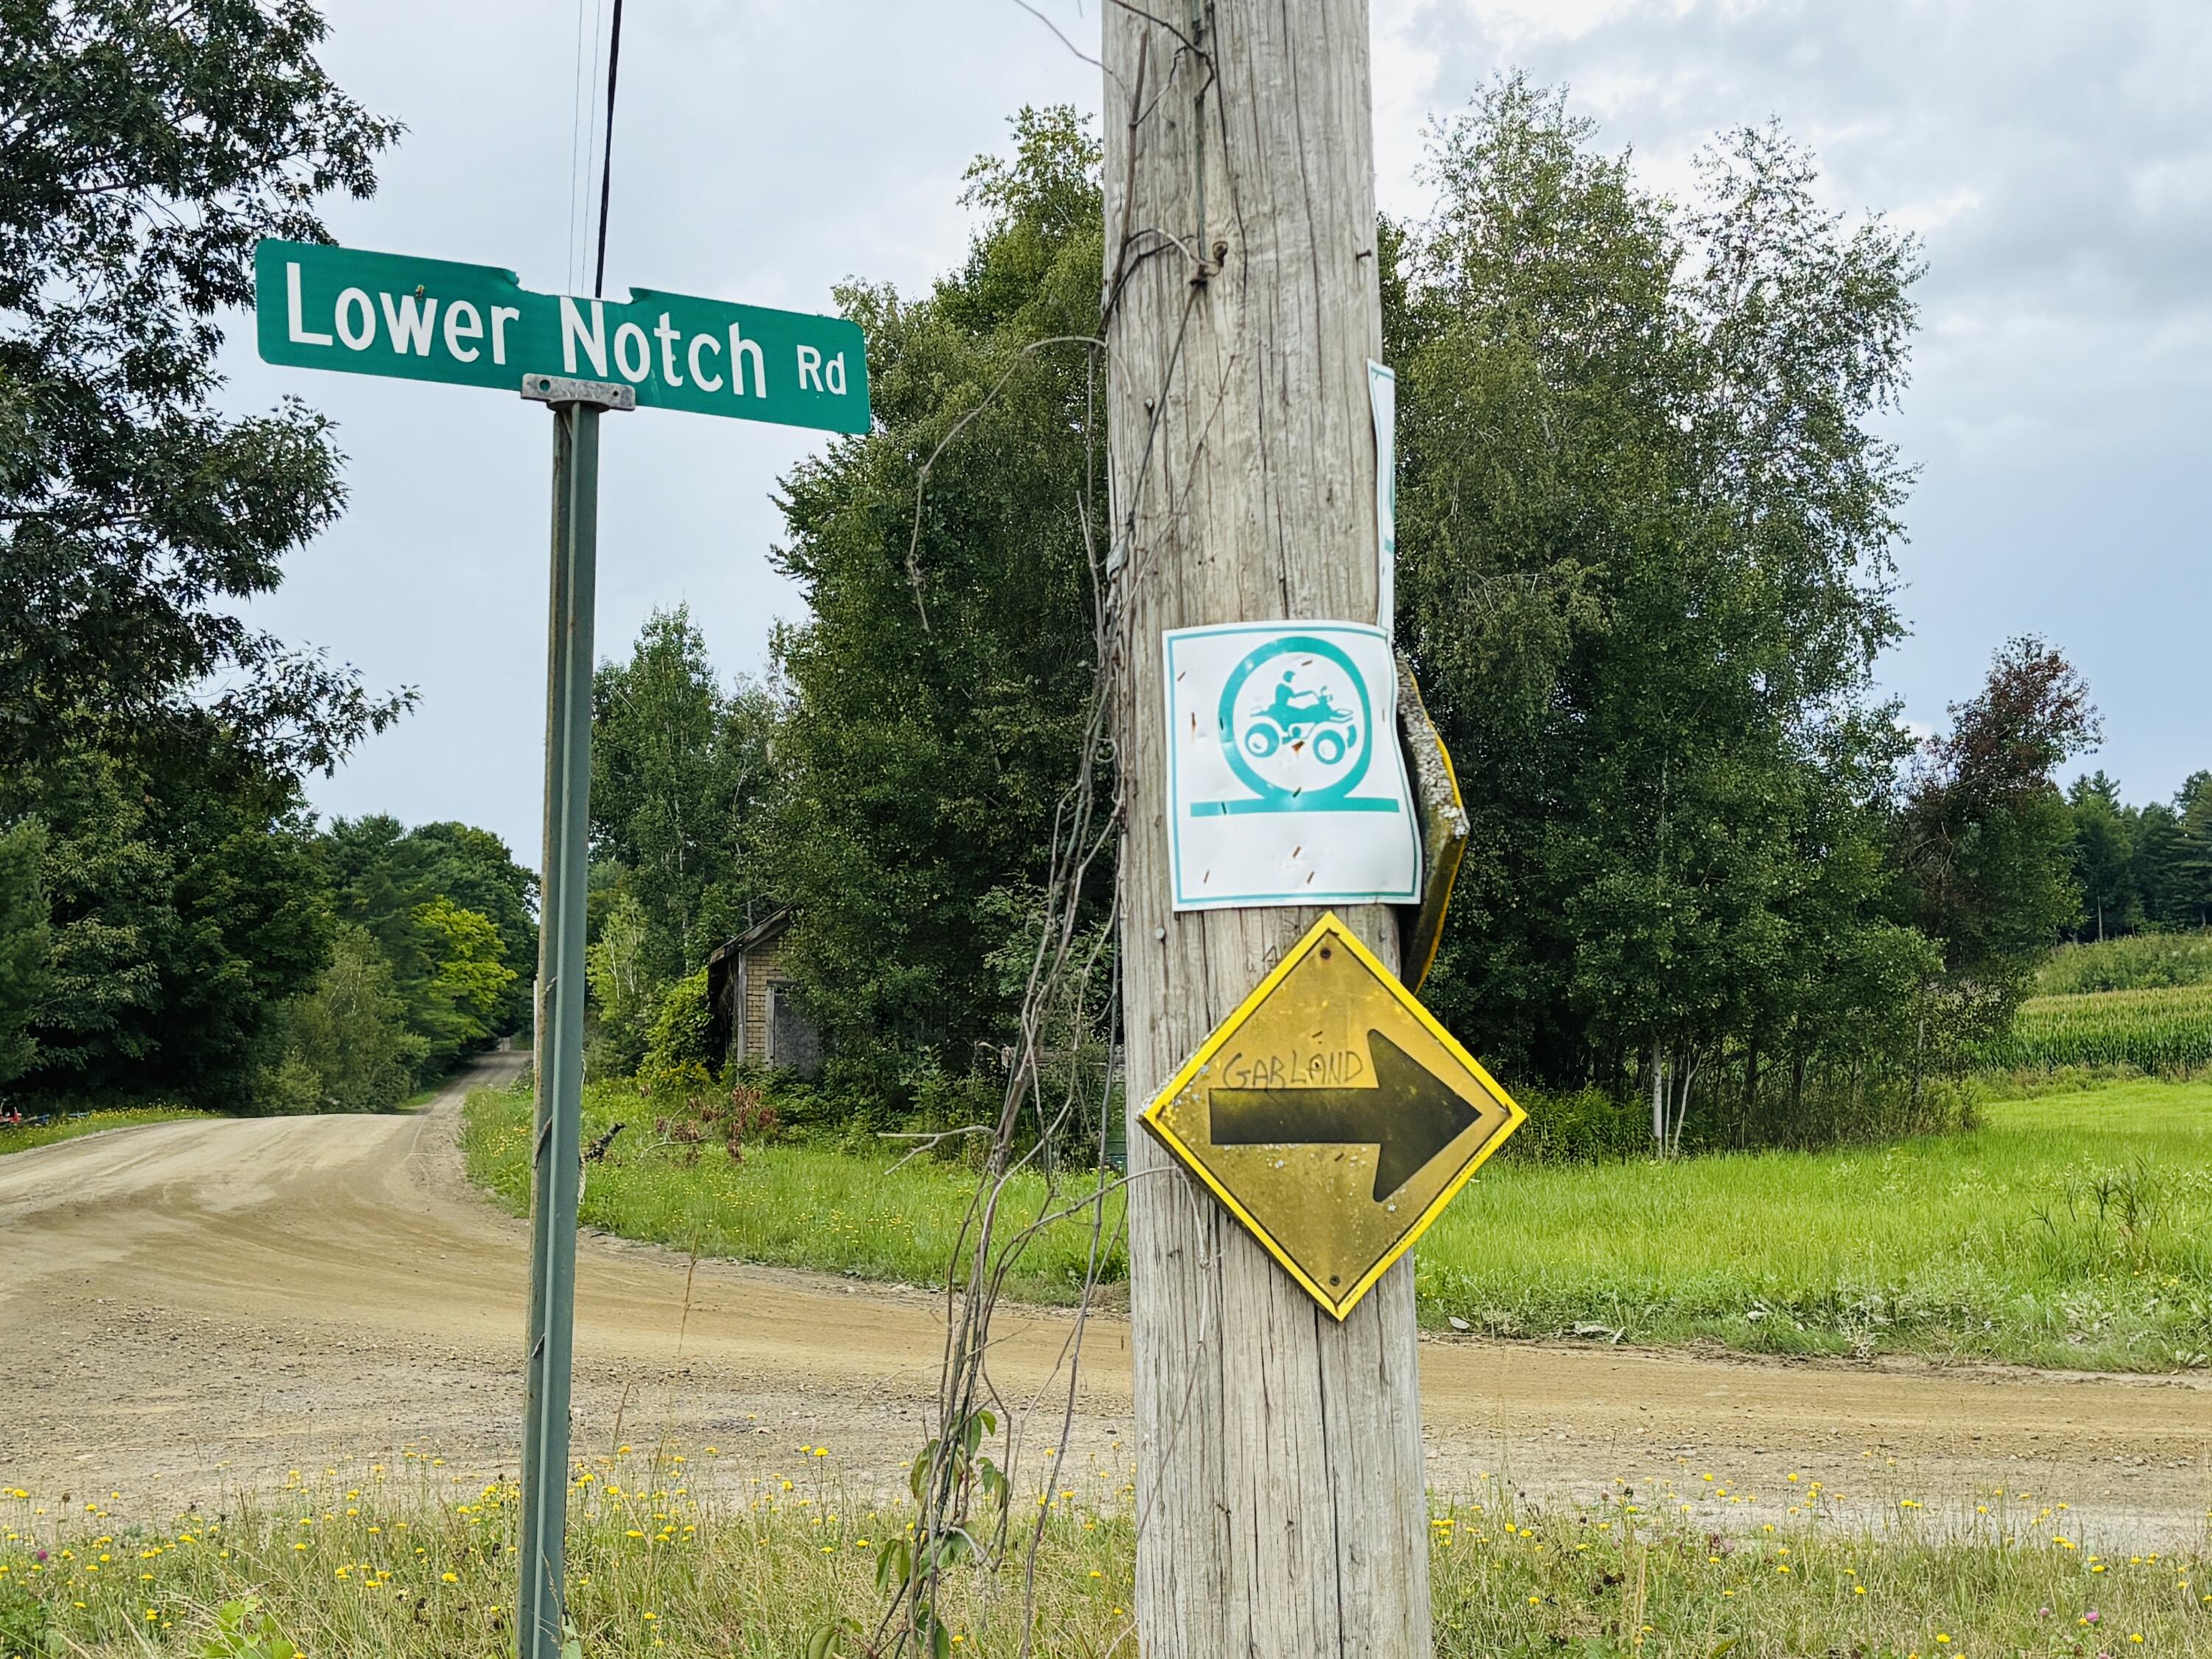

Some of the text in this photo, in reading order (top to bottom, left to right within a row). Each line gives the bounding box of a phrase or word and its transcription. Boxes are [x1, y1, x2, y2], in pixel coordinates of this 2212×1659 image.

[286, 262, 847, 399] Lower Notch Rd
[1223, 1049, 1363, 1090] GARLAND
